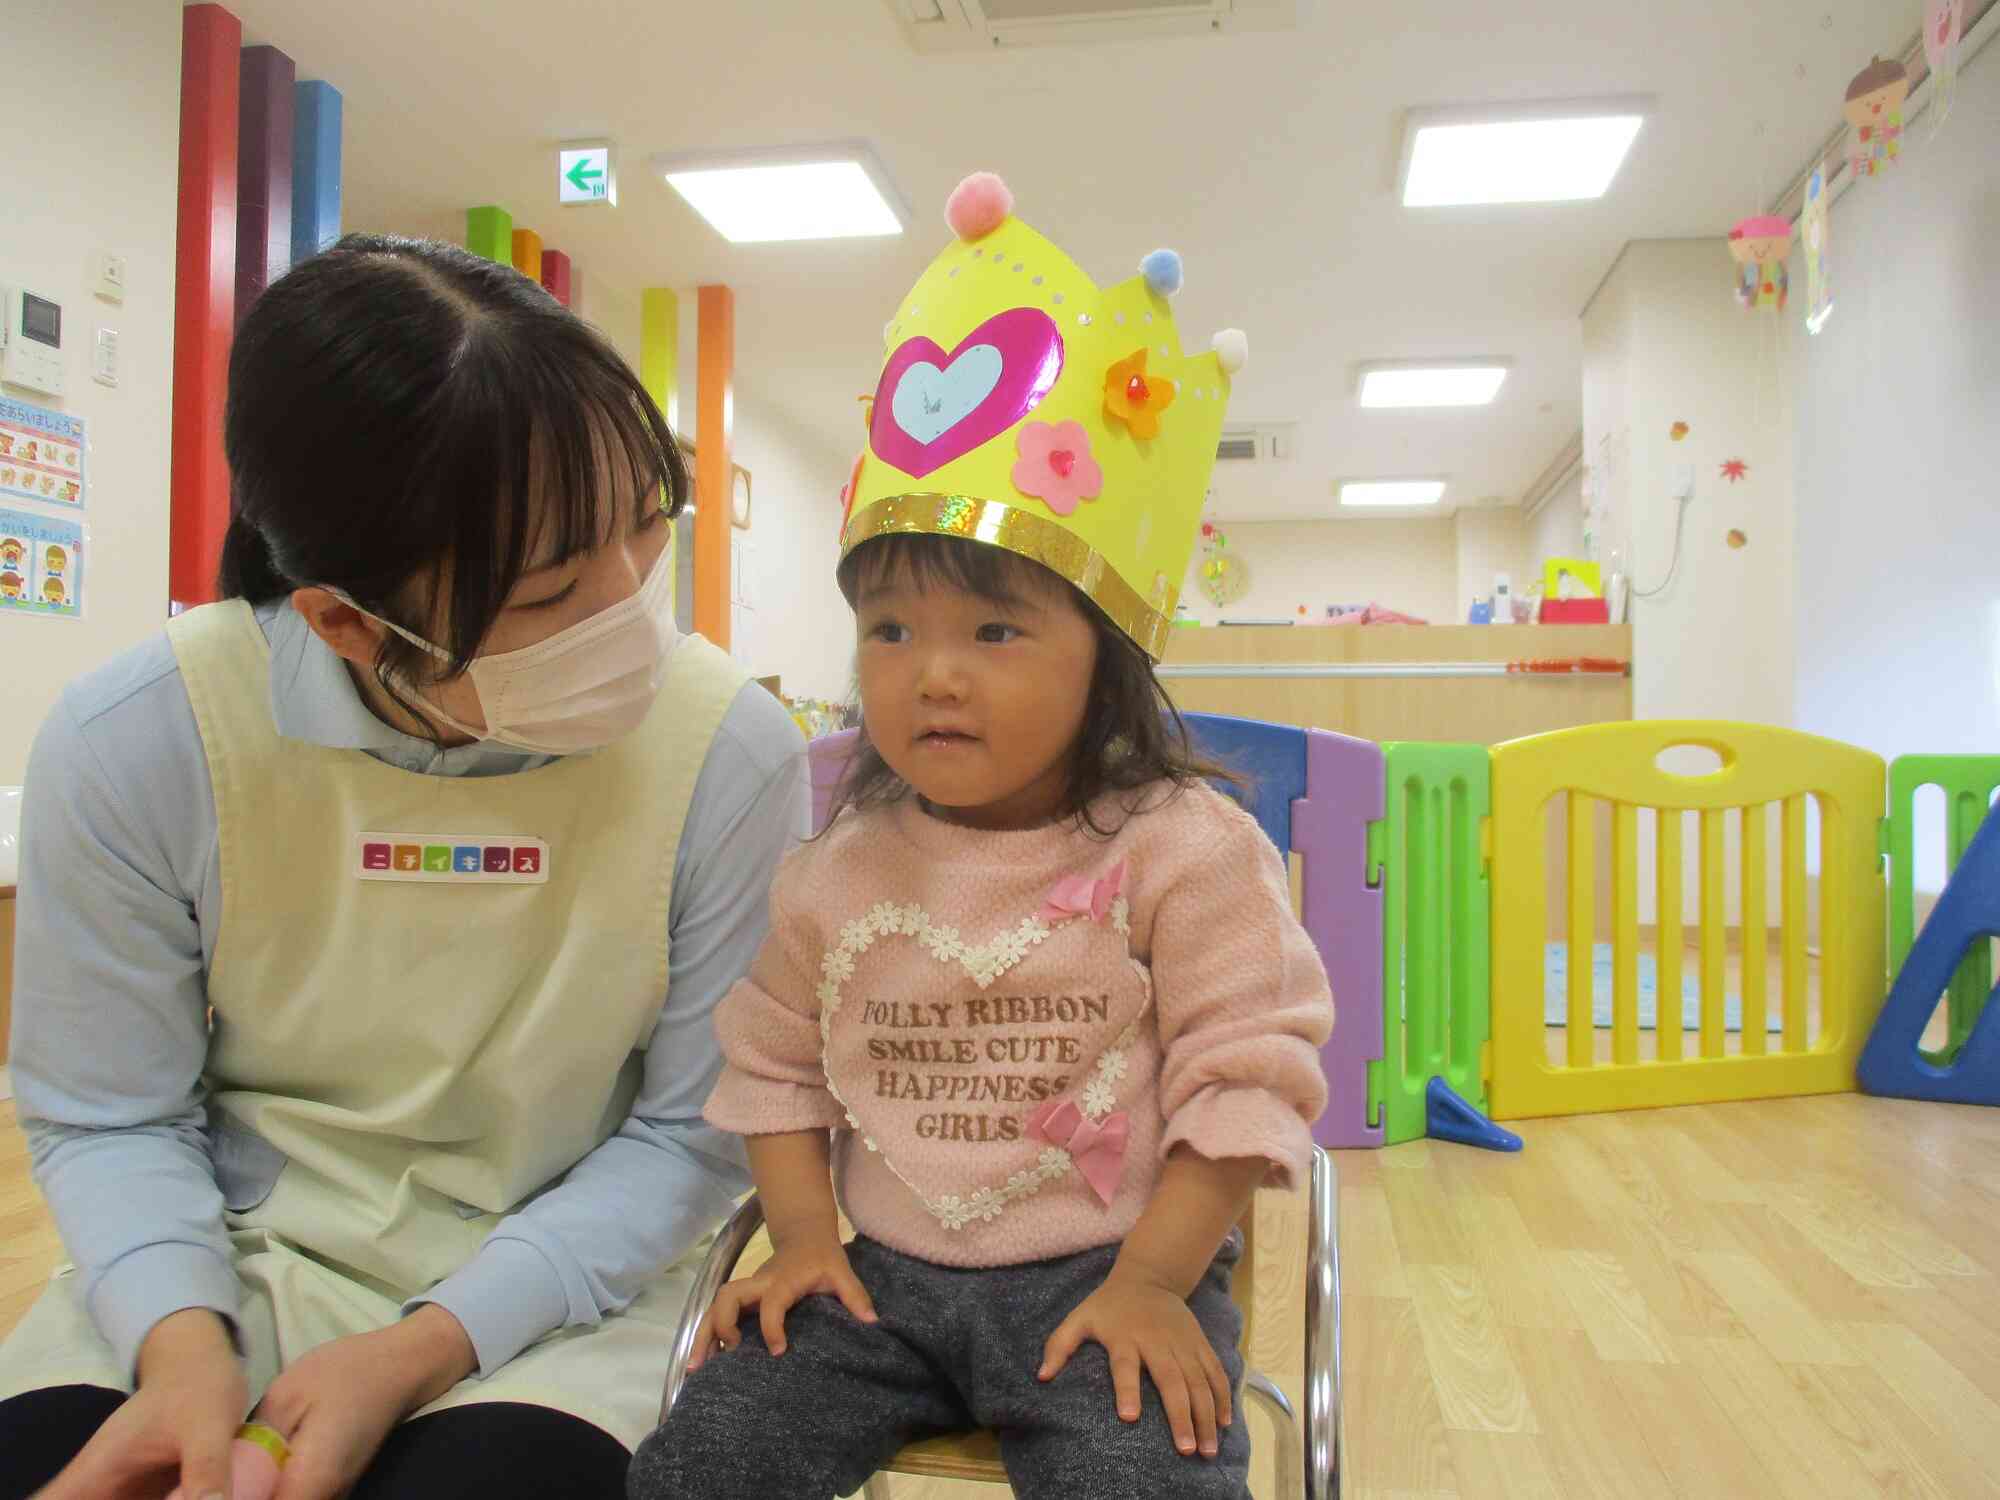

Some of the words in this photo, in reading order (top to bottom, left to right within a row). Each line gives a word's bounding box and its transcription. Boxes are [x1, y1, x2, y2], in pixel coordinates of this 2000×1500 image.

[364, 849, 539, 873] ニチイキッズ
[964, 995, 1109, 1027] RIBBON
[867, 1037, 977, 1063] SMILE
[985, 1035, 1080, 1064] CUTE
[874, 1070, 1071, 1102] HAPPINESS
[916, 1112, 1020, 1142] GIRLS
